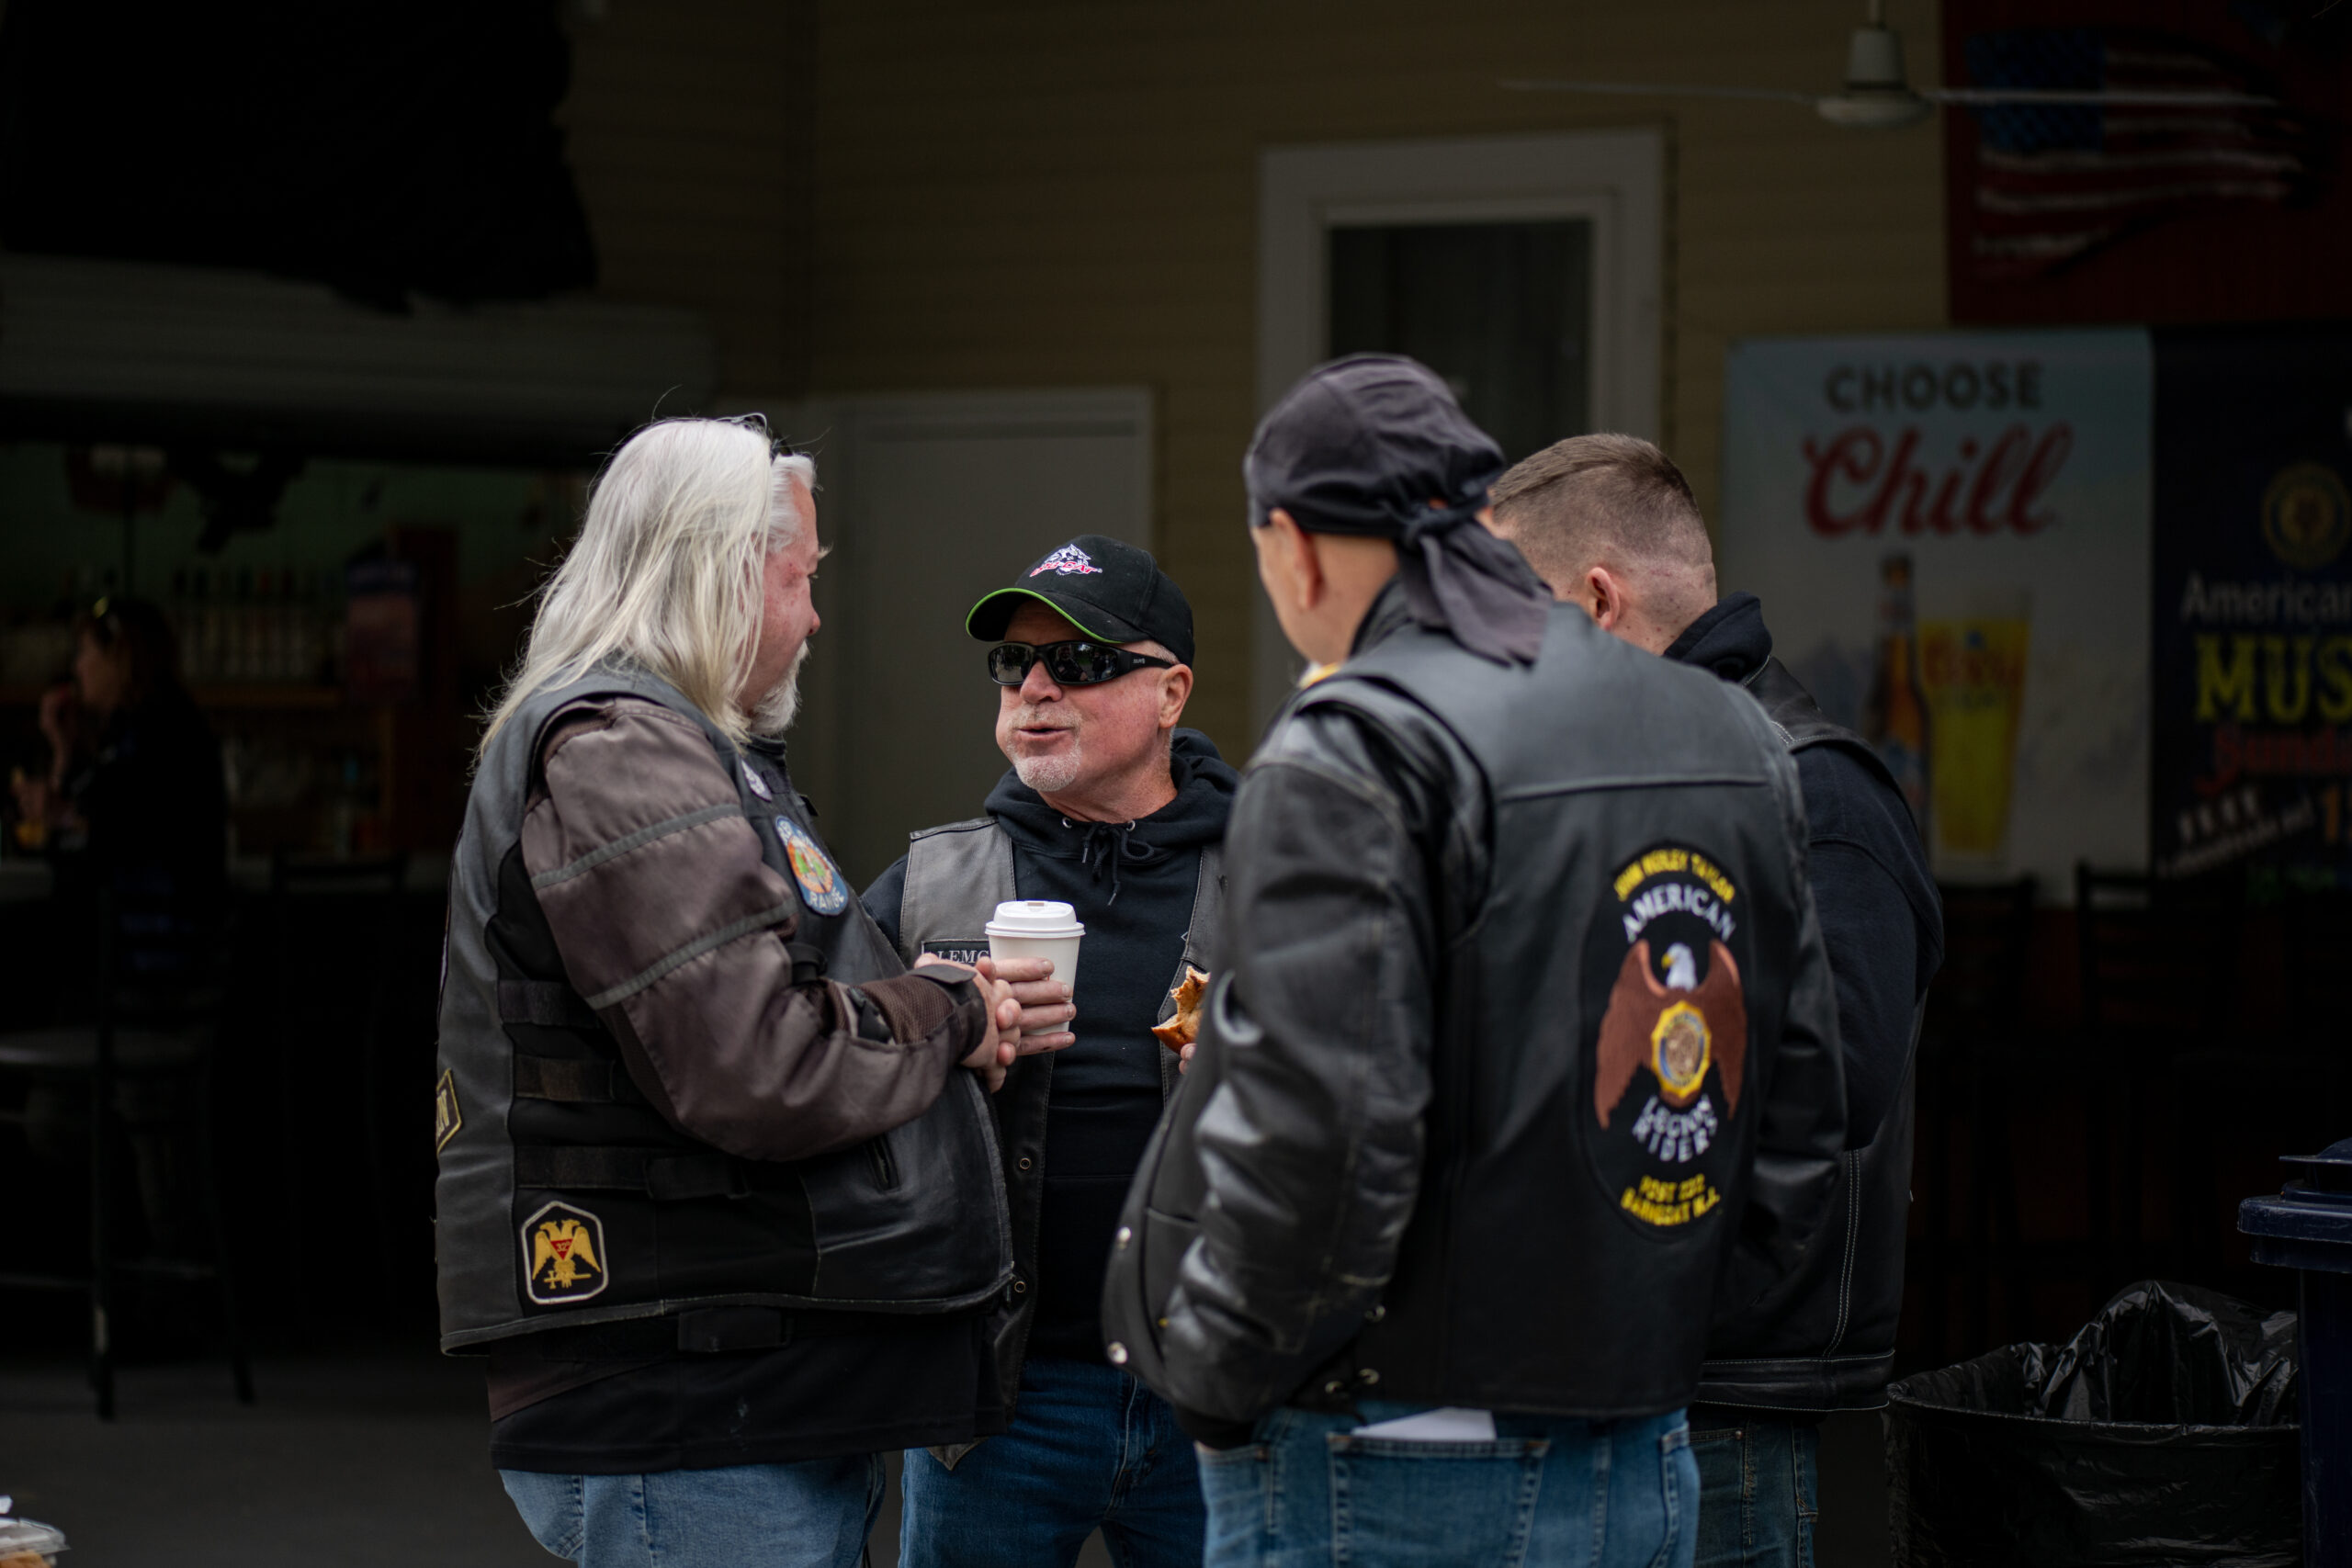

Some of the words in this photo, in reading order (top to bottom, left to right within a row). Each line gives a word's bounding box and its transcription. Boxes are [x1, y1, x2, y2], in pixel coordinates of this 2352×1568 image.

[1826, 364, 2041, 412] CHOOSE
[1802, 419, 2073, 537] Chill
[1622, 882, 1737, 944] AMERICAN
